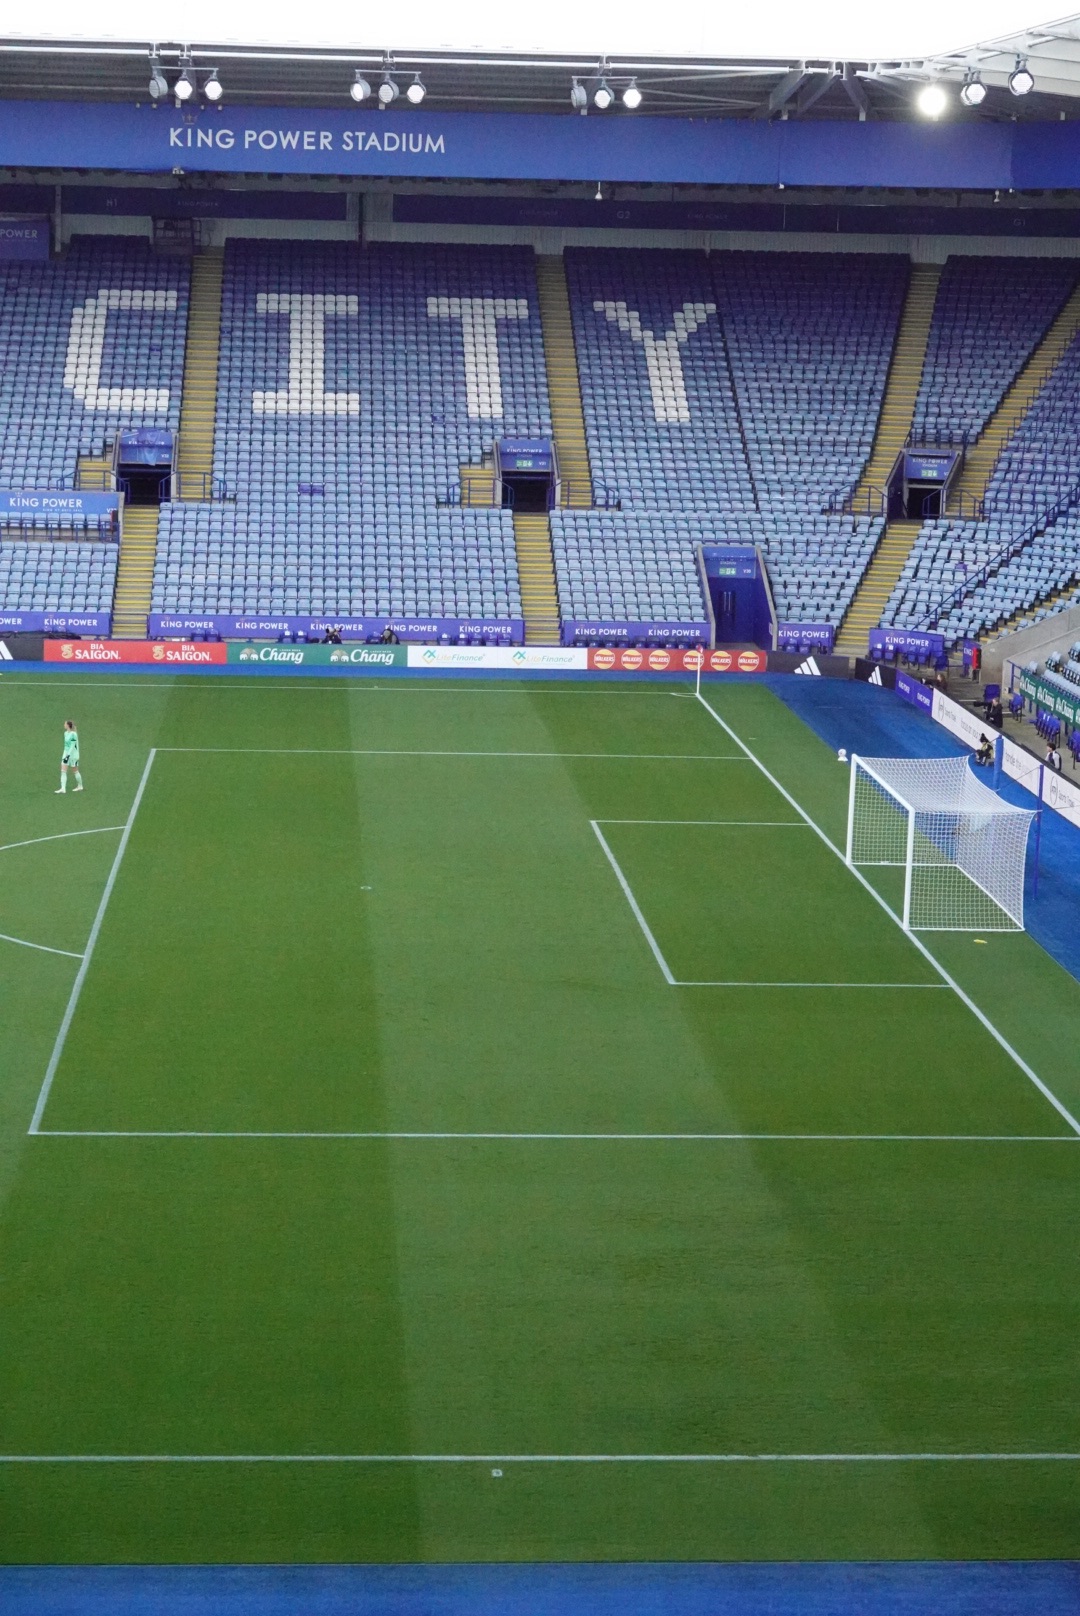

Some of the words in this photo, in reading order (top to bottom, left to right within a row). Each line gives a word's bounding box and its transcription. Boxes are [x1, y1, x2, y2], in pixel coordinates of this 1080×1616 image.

[169, 127, 235, 149] KING
[245, 129, 333, 152] POWER
[341, 131, 446, 154] STADIUM
[63, 289, 717, 423] CITY
[9, 498, 39, 507] KING
[42, 498, 83, 508] POWER
[44, 618, 66, 626] KING
[160, 620, 182, 628] KING
[184, 621, 214, 629] POWER
[259, 622, 289, 630] POWER
[459, 625, 481, 633] KING
[575, 628, 596, 636] KING
[598, 628, 628, 636] POWER
[648, 628, 669, 636] KING
[671, 629, 701, 637] POWER
[885, 636, 904, 644] KING
[906, 637, 930, 647] POWER
[260, 648, 304, 665] Chang
[350, 649, 395, 665] Chang
[594, 655, 615, 664] WALKERS
[621, 655, 643, 664] WALKERS
[649, 655, 670, 664] WALKERS
[683, 655, 704, 664] WALKERS
[711, 656, 732, 665] WALKERS
[738, 656, 759, 665] WALKERS
